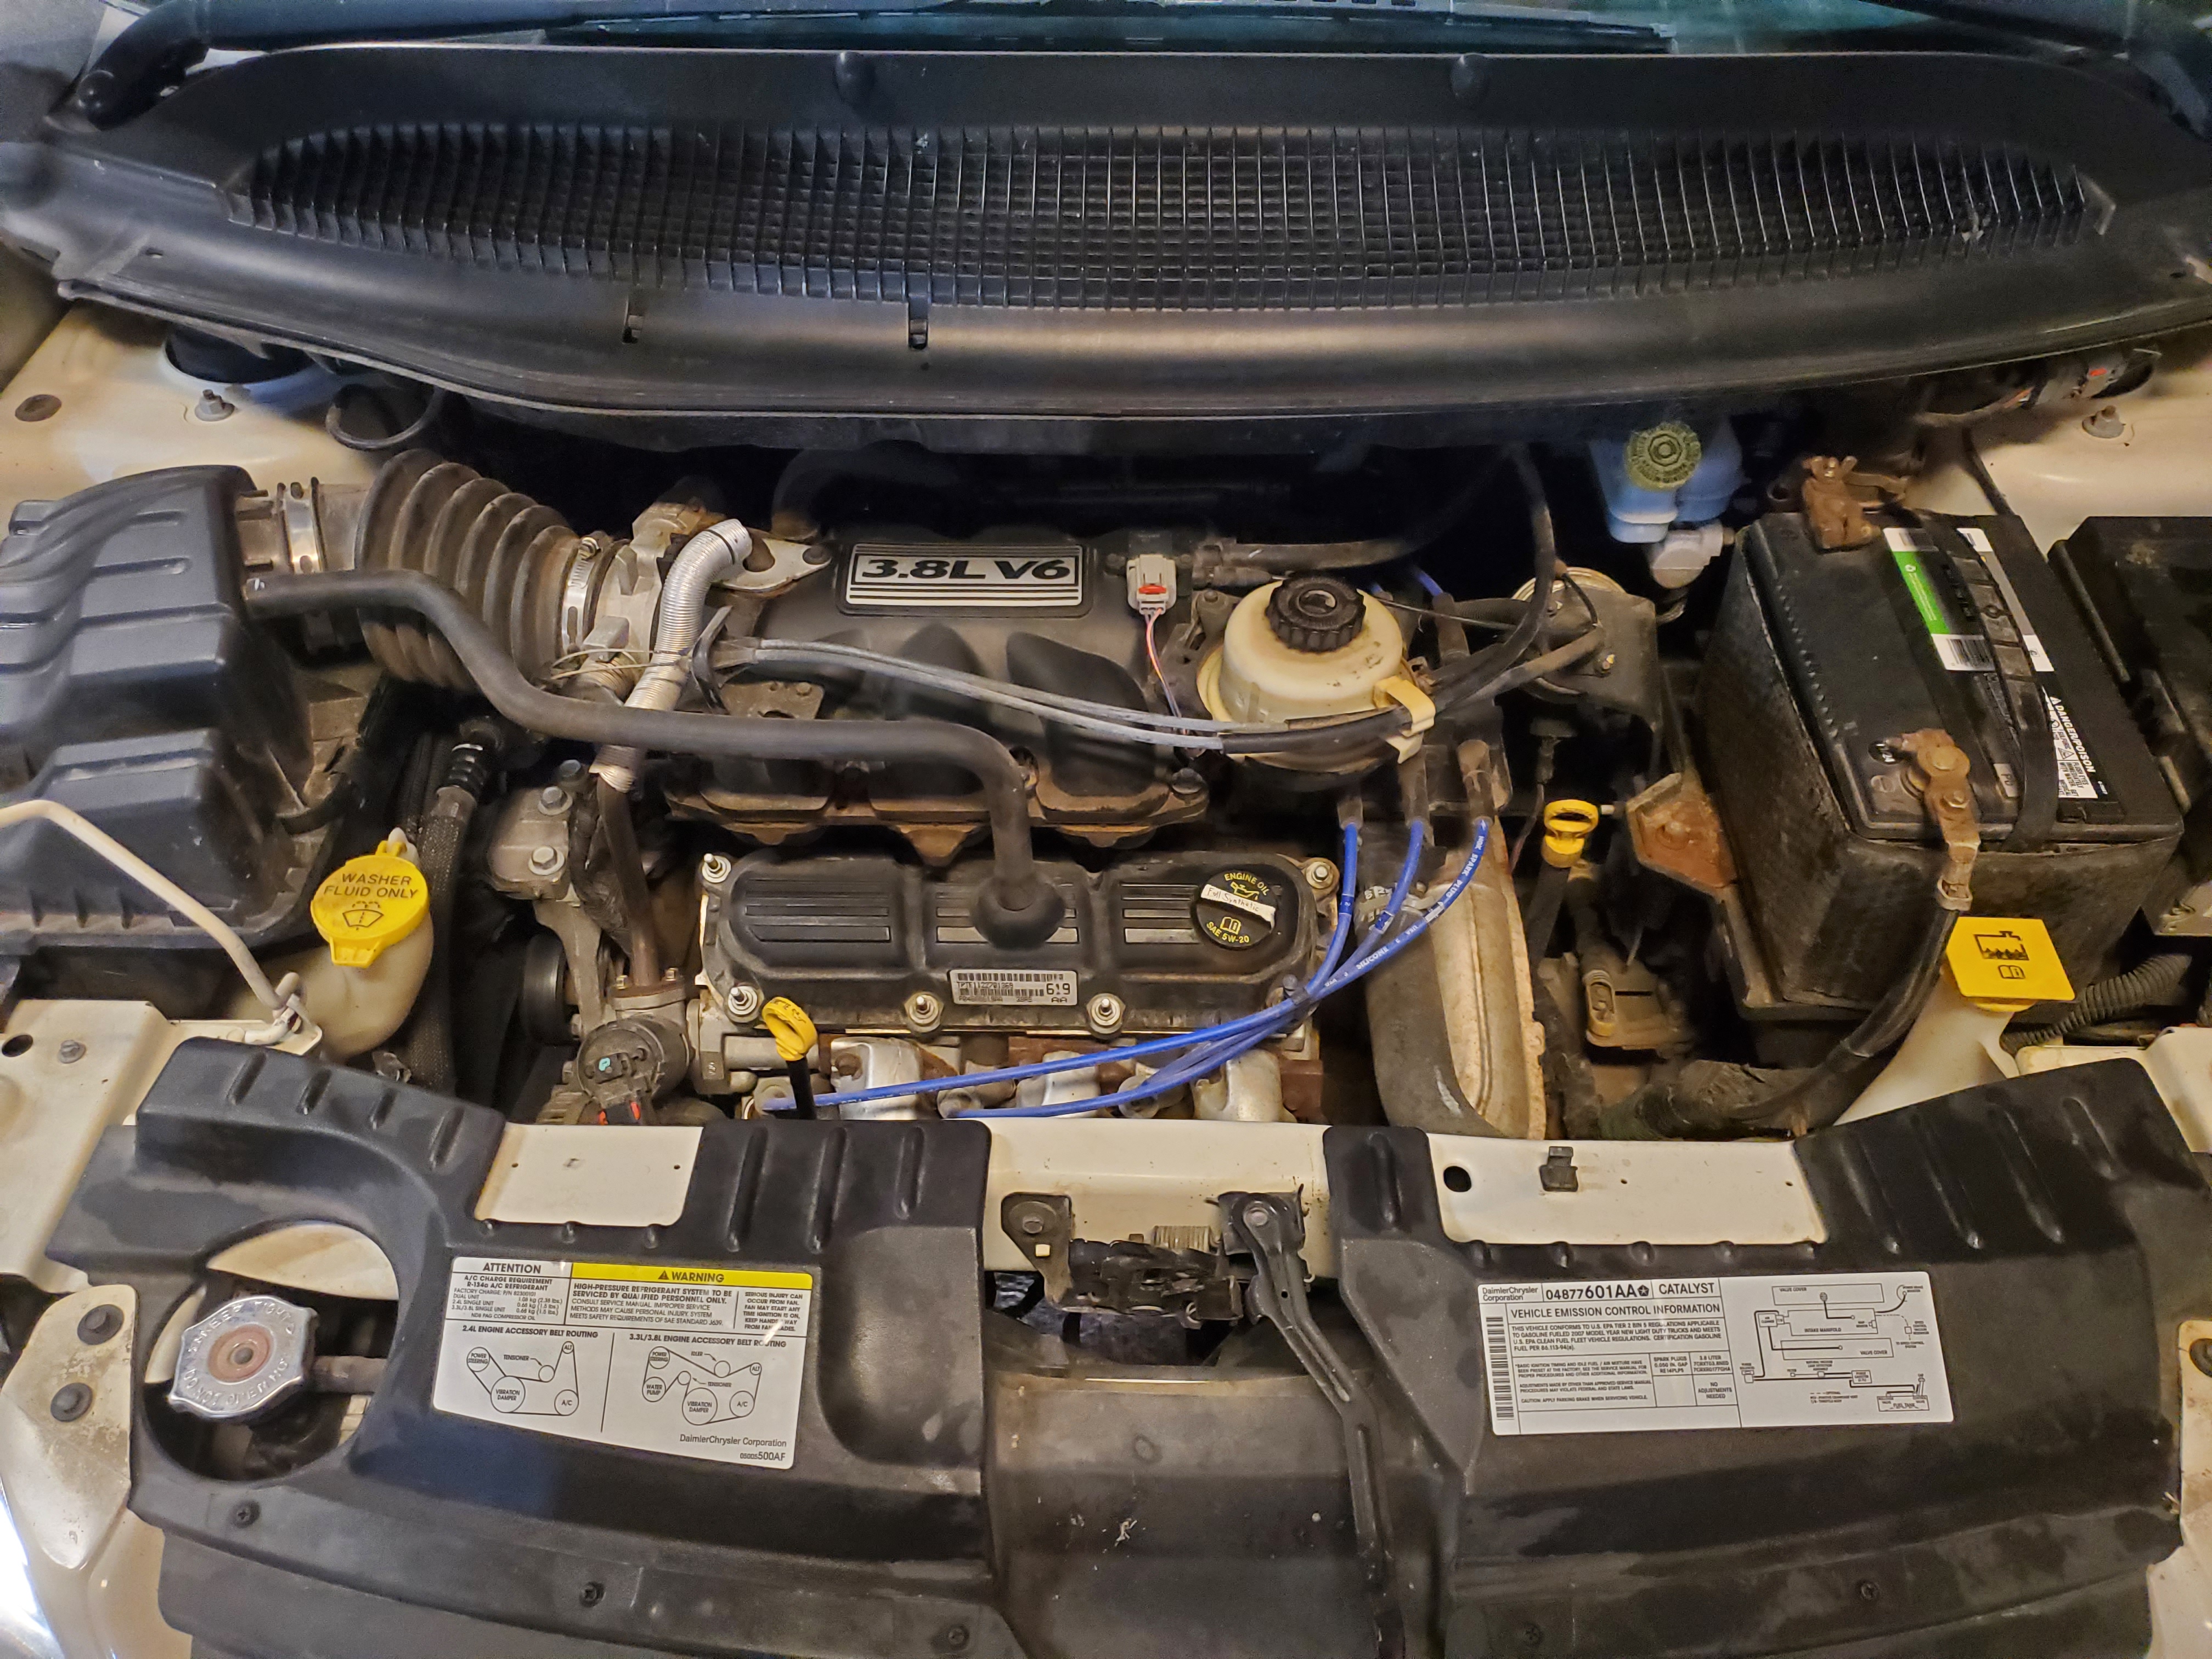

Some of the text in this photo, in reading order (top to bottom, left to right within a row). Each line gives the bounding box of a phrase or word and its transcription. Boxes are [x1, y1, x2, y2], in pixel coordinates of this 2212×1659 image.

[862, 558, 1070, 580] 3.8L V6
[2055, 706, 2096, 773] DANGER/POISON
[1462, 853, 1479, 877] SPARK
[342, 873, 412, 885] WASHER
[1224, 872, 1271, 896] ENGINE OIL
[324, 885, 419, 899] FLUID ONLY
[1446, 879, 1463, 898] PLUG
[1206, 921, 1250, 944] SAE 5W-20
[1356, 946, 1390, 970] SILICONE
[483, 1262, 541, 1274] ATTENTION
[672, 1272, 725, 1283] WARNING
[574, 1283, 629, 1292] HIGH-PRESSURE
[631, 1286, 680, 1294] REFRIGERANT
[1482, 1285, 1538, 1297] DaimlerChrysler
[1546, 1283, 1637, 1301] 04877601AA
[1658, 1282, 1714, 1295] CATALYST
[1483, 1293, 1523, 1303] Corporation
[1511, 1304, 1720, 1318] VEHICLE EMISSION CONTROL INFORMATION
[505, 1327, 548, 1335] ACCESSORY
[566, 1330, 599, 1338] ROUTING
[194, 1387, 222, 1406] NOT
[680, 1434, 787, 1447] DaimlerChrysler Corporation
